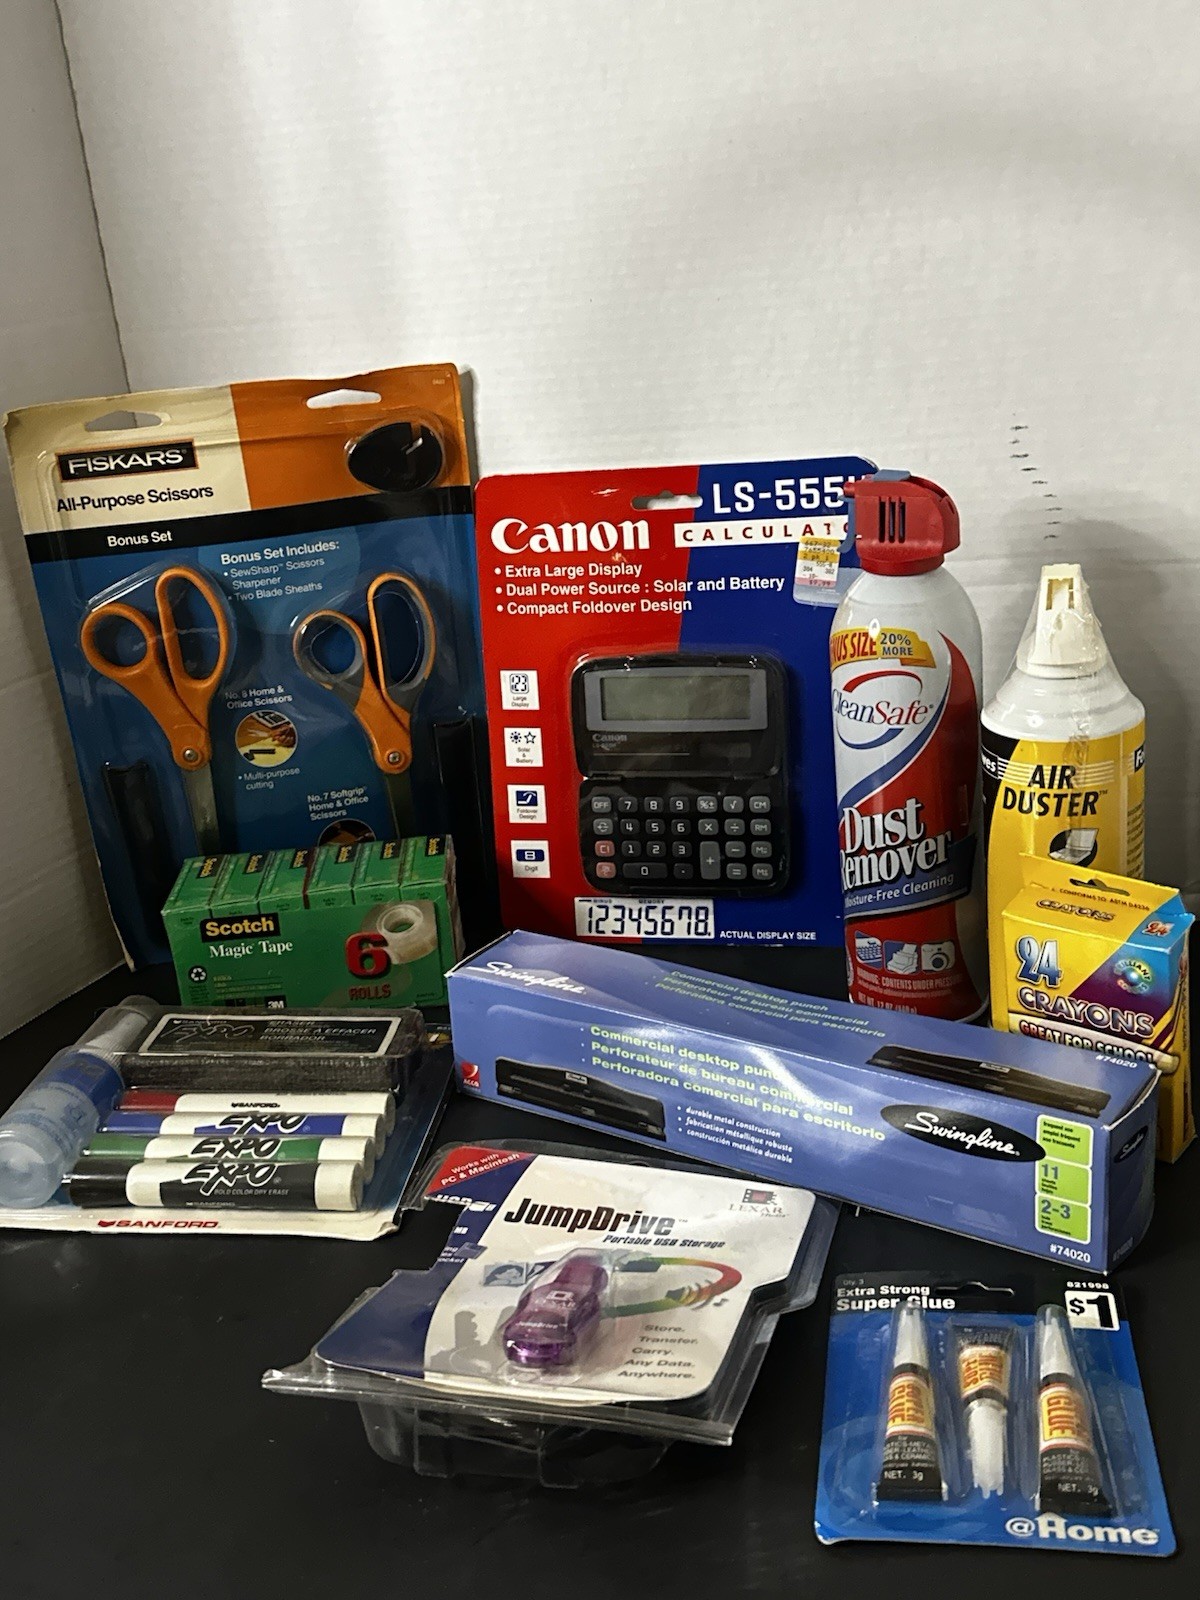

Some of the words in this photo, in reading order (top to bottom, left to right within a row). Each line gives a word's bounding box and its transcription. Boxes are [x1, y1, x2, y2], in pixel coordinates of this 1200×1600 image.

[69, 449, 184, 475] FISKARS
[57, 492, 145, 512] All-Purpose
[147, 486, 213, 503] Scissors
[713, 475, 867, 516] LS-555
[107, 535, 149, 547] Bonus
[151, 531, 172, 543] Set
[491, 518, 649, 555] Canon
[221, 552, 261, 565] Bonus
[263, 548, 284, 559] Set
[286, 541, 339, 556] Includes:
[230, 565, 279, 577] SewSharp
[286, 558, 324, 570] Scissors
[505, 565, 540, 578] Extra
[545, 564, 584, 580] Large
[588, 562, 642, 578] Display
[232, 577, 281, 590] Sharpener
[234, 592, 254, 601] Two
[256, 588, 283, 599] Blade
[285, 581, 323, 594] Sheaths
[506, 583, 536, 596] Dual
[541, 583, 584, 596] Power
[588, 582, 640, 595] Source
[654, 579, 693, 592] Solar
[697, 578, 725, 591] and
[730, 577, 785, 592] Battery
[507, 601, 569, 617] Compact
[572, 600, 636, 613] Foldover
[640, 598, 692, 615] Design
[850, 632, 877, 658] SIZE
[881, 633, 912, 645] 20%
[883, 646, 913, 656] MORE
[249, 688, 275, 698] Home
[277, 685, 285, 694] &
[255, 694, 293, 706] Scissors
[833, 689, 928, 727] CleanSafe
[244, 767, 300, 780] Multi-purpose
[1028, 765, 1077, 790] AIR
[246, 781, 274, 791] cutting
[307, 794, 322, 803] No.
[324, 792, 329, 801] 7
[309, 802, 335, 811] Home
[336, 800, 342, 808] &
[344, 795, 369, 806] Office
[1003, 786, 1100, 818] DUSTER
[310, 809, 347, 821] Scissors
[843, 798, 924, 854] Dust
[902, 873, 954, 896] Cleaning
[206, 917, 275, 937] Scotch
[720, 930, 754, 940] ACTUAL
[756, 931, 795, 940] DISPLAY
[797, 932, 816, 941] SIZE
[209, 943, 254, 959] Magic
[259, 940, 294, 956] Tape
[345, 932, 391, 979] 6
[1016, 935, 1062, 989] 24
[466, 961, 588, 995] Swingline
[881, 975, 912, 990] CONTENTS
[349, 984, 391, 1001] ROLLS
[670, 970, 739, 993] Commercial
[740, 986, 788, 1004] desktop
[790, 1000, 829, 1011] punch
[655, 982, 725, 1005] Perforadora
[728, 1001, 787, 1020] comercial
[789, 1016, 819, 1026] para
[822, 1023, 886, 1038] escritorio
[664, 977, 731, 998] Perforateur
[750, 998, 793, 1011] bureau
[795, 1010, 869, 1026] commercial
[1018, 986, 1155, 1038] CRAYONS
[1020, 1021, 1062, 1043] GREAT
[1065, 1034, 1093, 1051] FOR
[590, 1026, 675, 1055] Commercial
[678, 1043, 740, 1072] desktop
[744, 1063, 784, 1082] punc
[1095, 1053, 1138, 1068] #74020
[591, 1042, 674, 1070] Perforateur
[679, 1060, 697, 1076] de
[700, 1068, 755, 1091] bureau
[592, 1056, 679, 1087] Perforadora
[683, 1081, 758, 1107] comercial
[762, 1100, 798, 1119] para
[803, 1110, 886, 1141] escritorio
[215, 1110, 310, 1136] EXPO
[685, 1107, 712, 1121] durable
[714, 1114, 735, 1125] metal
[736, 1119, 781, 1138] construction
[685, 1117, 724, 1133] fabrication
[726, 1126, 763, 1145] métallique
[765, 1137, 793, 1153] robuste
[904, 1111, 1021, 1156] Swingline
[187, 1136, 282, 1159] EXPO
[686, 1128, 730, 1146] construcción
[732, 1139, 763, 1155] metálica
[764, 1149, 793, 1164] durable
[441, 1175, 457, 1185] PC
[459, 1171, 467, 1179] &
[470, 1154, 520, 1175] Macintosh
[451, 1161, 479, 1174] Works
[480, 1153, 499, 1163] with
[1041, 1164, 1058, 1180] 11
[180, 1160, 280, 1196] EXPO
[268, 1188, 289, 1196] ERASE
[503, 1198, 677, 1237] JumpDrive
[729, 1204, 783, 1214] LEXAR
[1041, 1199, 1071, 1219] 2-3
[116, 1219, 219, 1229] SANFORD
[602, 1234, 653, 1247] Portable
[653, 1238, 678, 1248] USB
[679, 1239, 726, 1250] Storage
[1050, 1243, 1091, 1263] #74020
[837, 1286, 875, 1298] Extra
[880, 1284, 931, 1296] Strong
[1067, 1281, 1110, 1290] 821998
[836, 1297, 900, 1312] Super
[907, 1296, 955, 1310] Glue
[1069, 1295, 1116, 1330] $1
[644, 1324, 685, 1333] Store.
[639, 1335, 698, 1345] Transfer.
[632, 1347, 673, 1356] Carry.
[625, 1359, 652, 1368] Any
[657, 1359, 694, 1367] Data.
[618, 1370, 695, 1379] Anywhere.
[1047, 1395, 1077, 1436] GLUE
[884, 1470, 906, 1479] NET.
[1005, 1512, 1160, 1546] @Home
